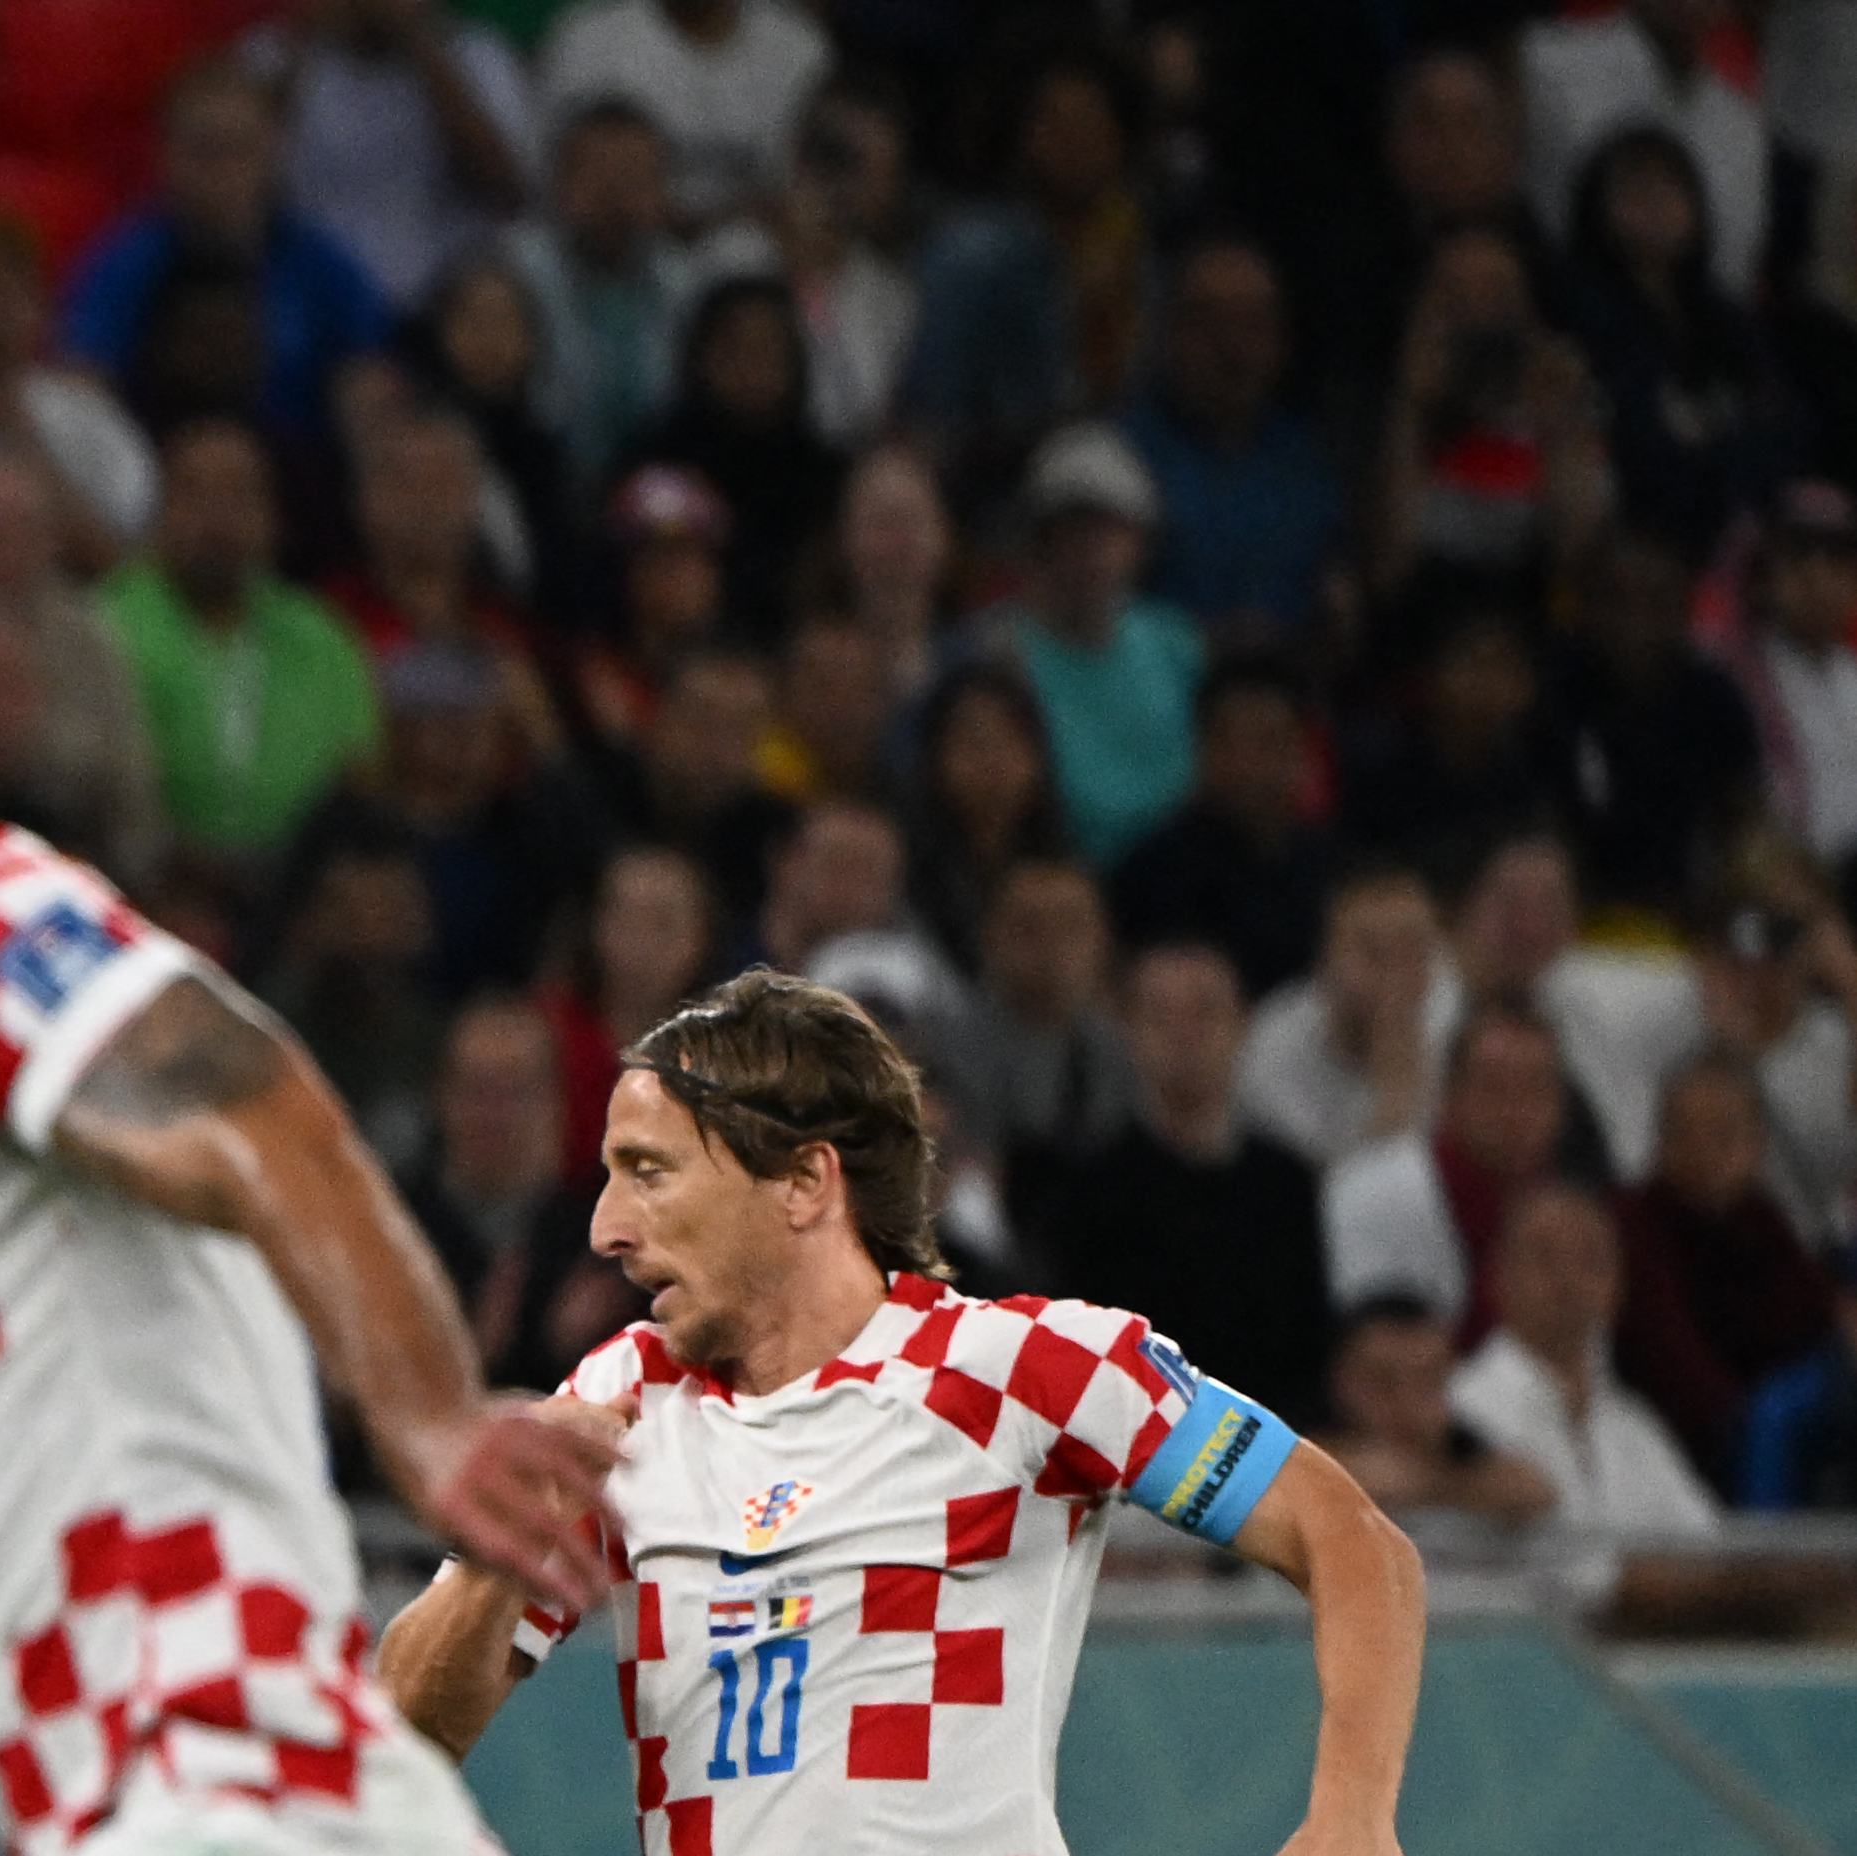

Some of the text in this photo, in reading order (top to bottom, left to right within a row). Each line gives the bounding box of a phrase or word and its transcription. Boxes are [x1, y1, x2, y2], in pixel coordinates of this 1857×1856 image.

[1161, 1407, 1244, 1519] PROTECT
[1181, 1415, 1263, 1529] CHILDREN
[707, 1638, 811, 1781] 10
